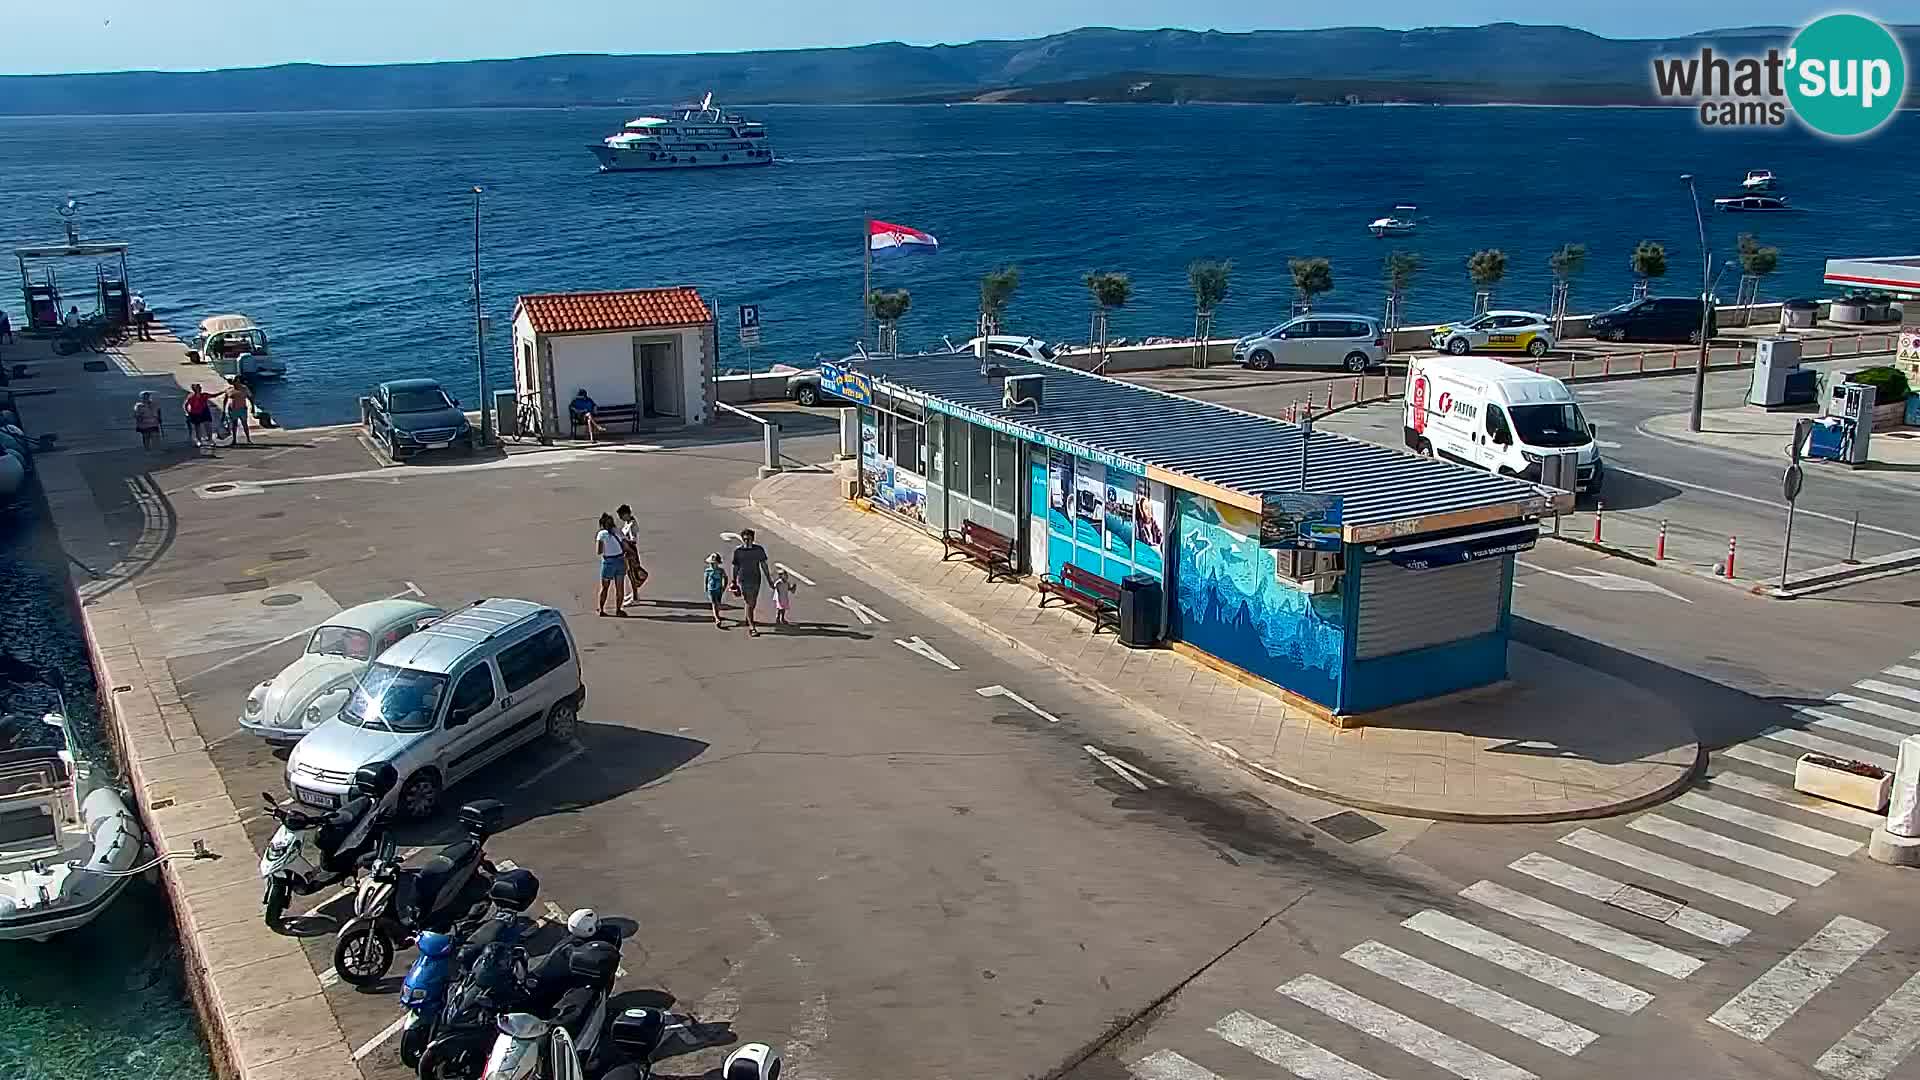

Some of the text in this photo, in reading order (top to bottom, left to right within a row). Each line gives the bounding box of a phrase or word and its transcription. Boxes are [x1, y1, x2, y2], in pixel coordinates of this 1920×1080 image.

[743, 308, 754, 325] P
[1454, 400, 1477, 418] PASTOR
[1006, 424, 1035, 441] POSTAJA
[1044, 435, 1058, 448] BUS
[1058, 439, 1089, 458] STATION
[1090, 451, 1115, 466] TICKET
[1115, 457, 1143, 473] OFFICE
